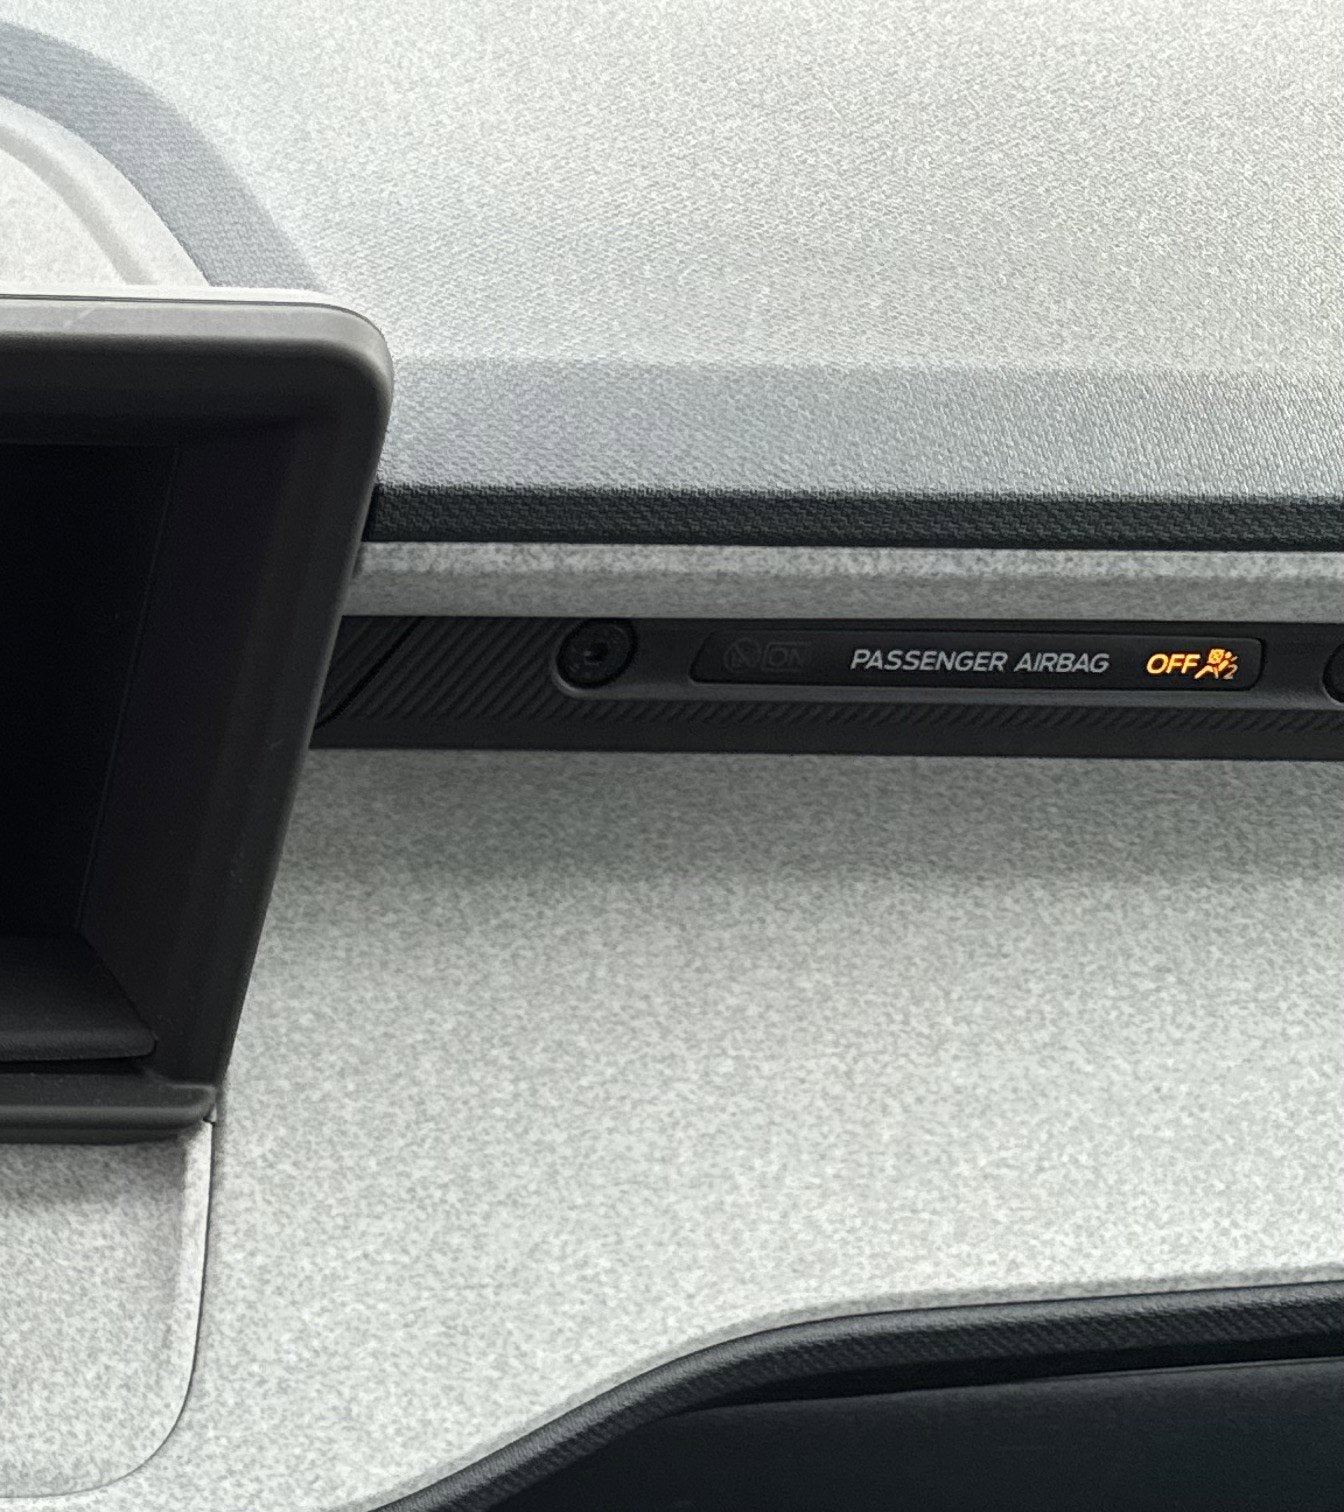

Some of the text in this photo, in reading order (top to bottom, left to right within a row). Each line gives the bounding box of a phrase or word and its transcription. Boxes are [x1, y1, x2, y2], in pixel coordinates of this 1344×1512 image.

[850, 649, 1201, 674] PASSENGER AIRBAG OFF
